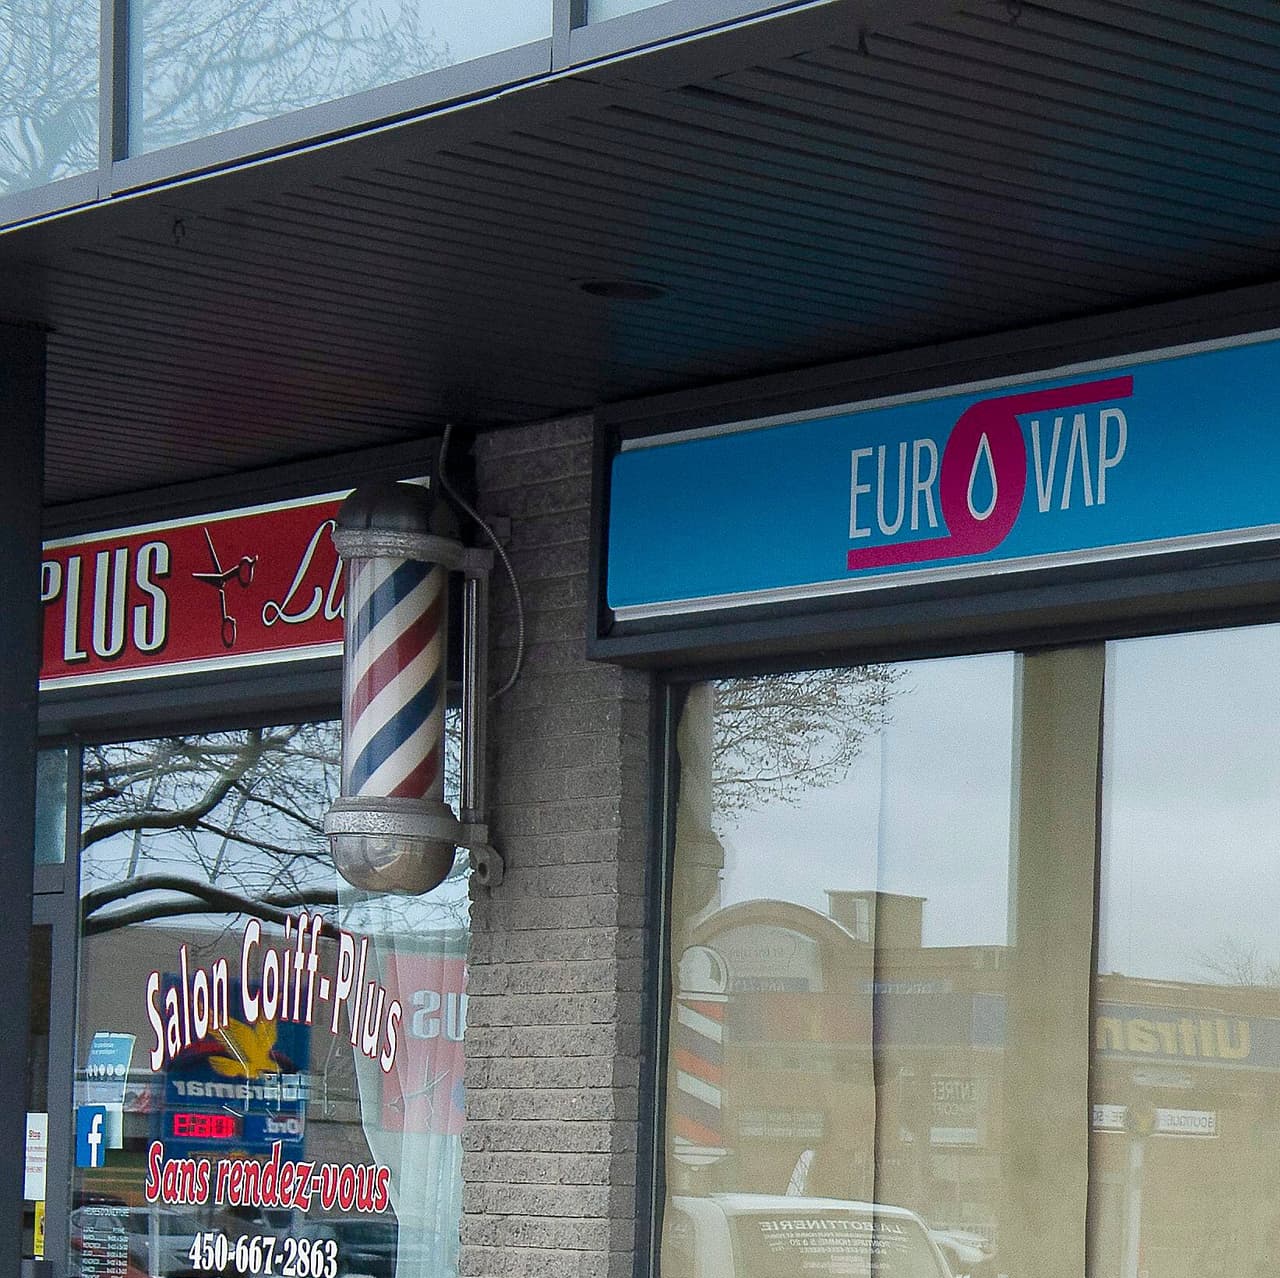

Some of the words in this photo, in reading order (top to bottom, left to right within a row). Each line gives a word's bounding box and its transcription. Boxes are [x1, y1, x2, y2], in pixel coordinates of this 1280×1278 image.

[41, 541, 169, 661] PLUS
[146, 944, 229, 1073] Salon
[240, 911, 402, 1073] Coiff-Plus
[146, 1140, 209, 1205] Sans
[215, 1141, 391, 1213] rendez-vous
